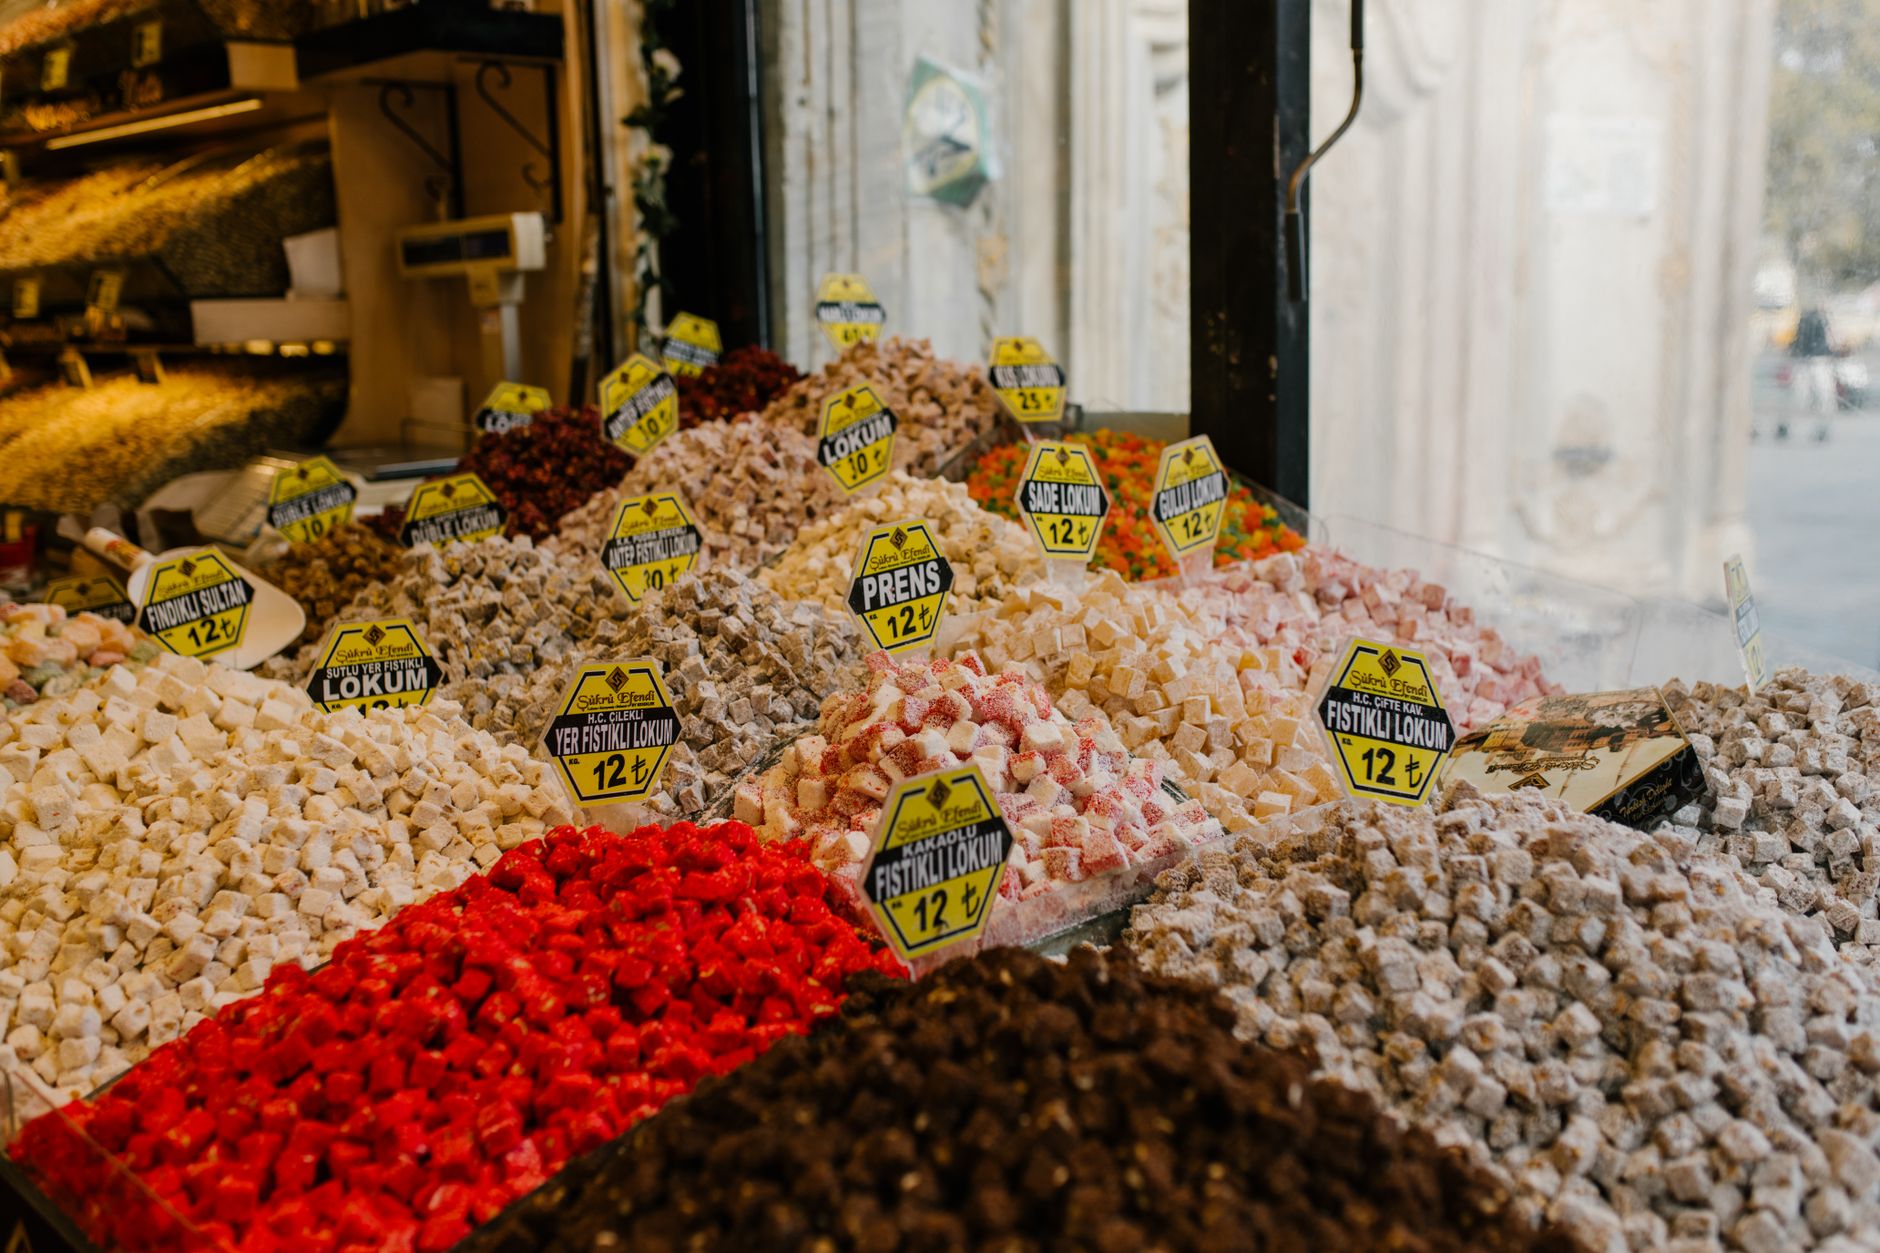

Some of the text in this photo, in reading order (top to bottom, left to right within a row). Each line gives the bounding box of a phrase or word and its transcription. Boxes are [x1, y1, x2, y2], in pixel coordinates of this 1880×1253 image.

[823, 414, 893, 466] LOKUM
[1028, 481, 1102, 517] SADE LOKUM
[454, 508, 501, 538] LOKUM
[1049, 518, 1074, 545] 12
[1183, 512, 1203, 539] 12
[862, 560, 941, 612] PRENS
[146, 579, 247, 633] FINDIKLI SULTAN
[887, 605, 916, 639] 12
[188, 618, 221, 648] 12
[322, 667, 428, 702] LOKUM
[361, 661, 382, 675] YER
[555, 718, 673, 756] YER FISTIKLI LOKUM
[1327, 700, 1448, 751] FISTIKLI LOKUM
[593, 753, 627, 791] 12
[1361, 746, 1396, 787] 12
[902, 823, 978, 860] KAKAOLU
[875, 829, 1003, 904] FISTIKLI LOKUM
[913, 889, 949, 933] 12
